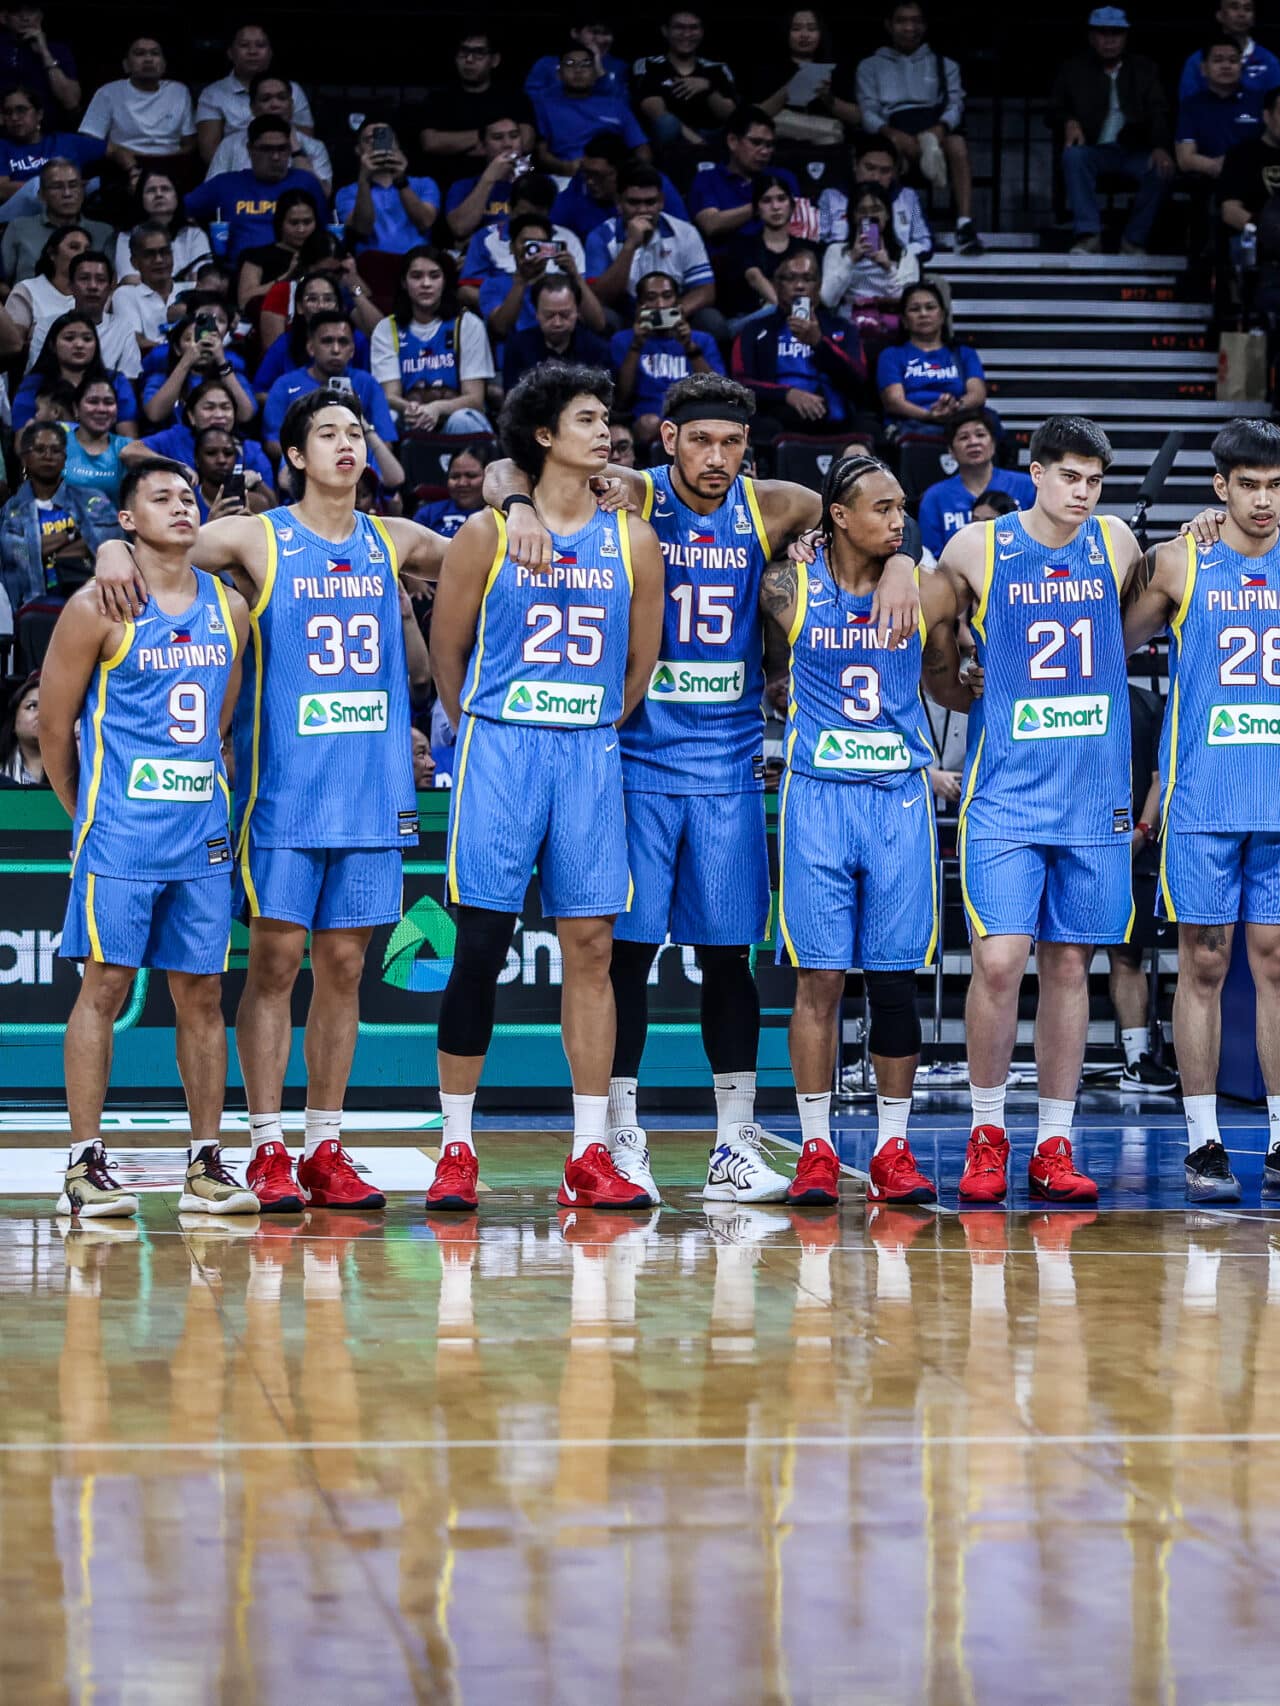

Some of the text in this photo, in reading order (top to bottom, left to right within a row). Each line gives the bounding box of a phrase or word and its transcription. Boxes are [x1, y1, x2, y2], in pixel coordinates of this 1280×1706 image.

[659, 542, 747, 569] PILIPINAS
[293, 576, 383, 598] PILIPINAS
[1009, 579, 1103, 604] PILIPINAS
[670, 584, 734, 644] 15
[307, 614, 380, 675] 33
[523, 604, 605, 666] 25
[1027, 618, 1092, 679] 21
[138, 644, 226, 671] PILIPINAS
[679, 671, 740, 692] Smart
[841, 665, 880, 721] 3
[168, 683, 206, 743] 9
[331, 700, 383, 722] Smart
[536, 684, 599, 715] Smart
[1043, 704, 1102, 728] Smart
[845, 739, 907, 760] Smart
[162, 768, 212, 792] Smart
[0, 929, 85, 984] ar
